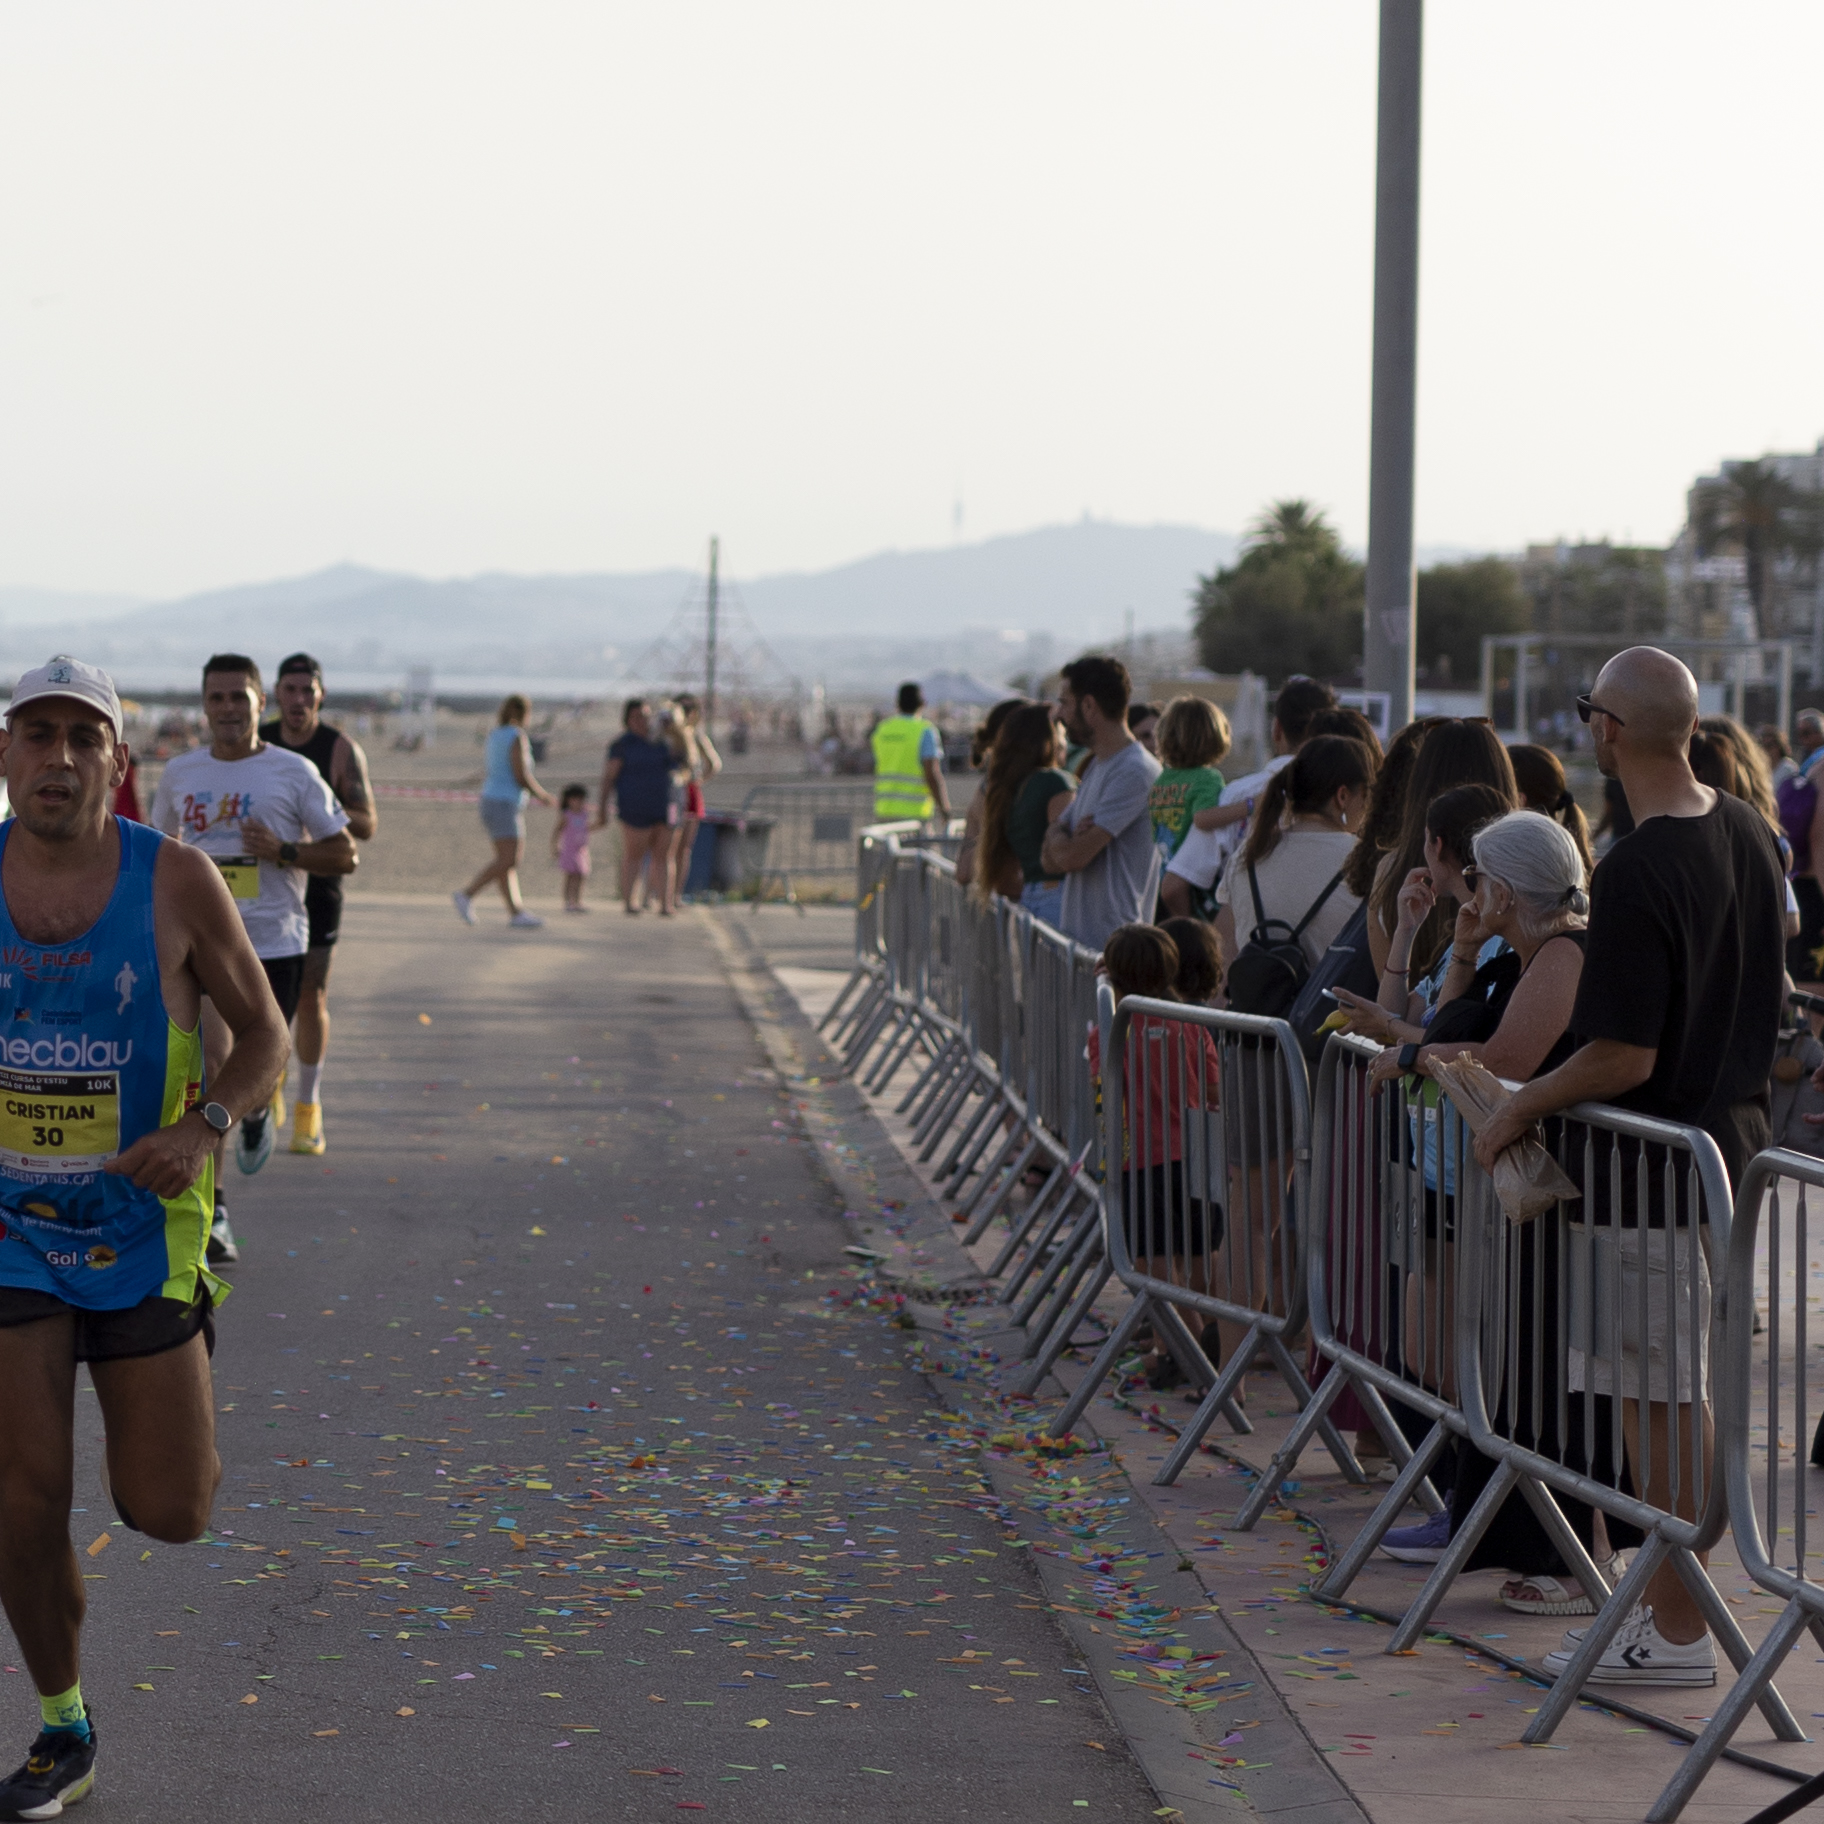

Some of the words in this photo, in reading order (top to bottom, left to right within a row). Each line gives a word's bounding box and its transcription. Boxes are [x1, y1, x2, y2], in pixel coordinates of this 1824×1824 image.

[183, 794, 207, 832] 25
[42, 950, 92, 967] FILSA
[11, 1074, 35, 1083] CURSA
[36, 1077, 68, 1085] D'ESTIU
[87, 1080, 112, 1091] 10K
[24, 1084, 42, 1092] MAR
[6, 1100, 95, 1121] CRISTIAN
[32, 1126, 64, 1147] 30
[46, 1251, 78, 1266] Gol
